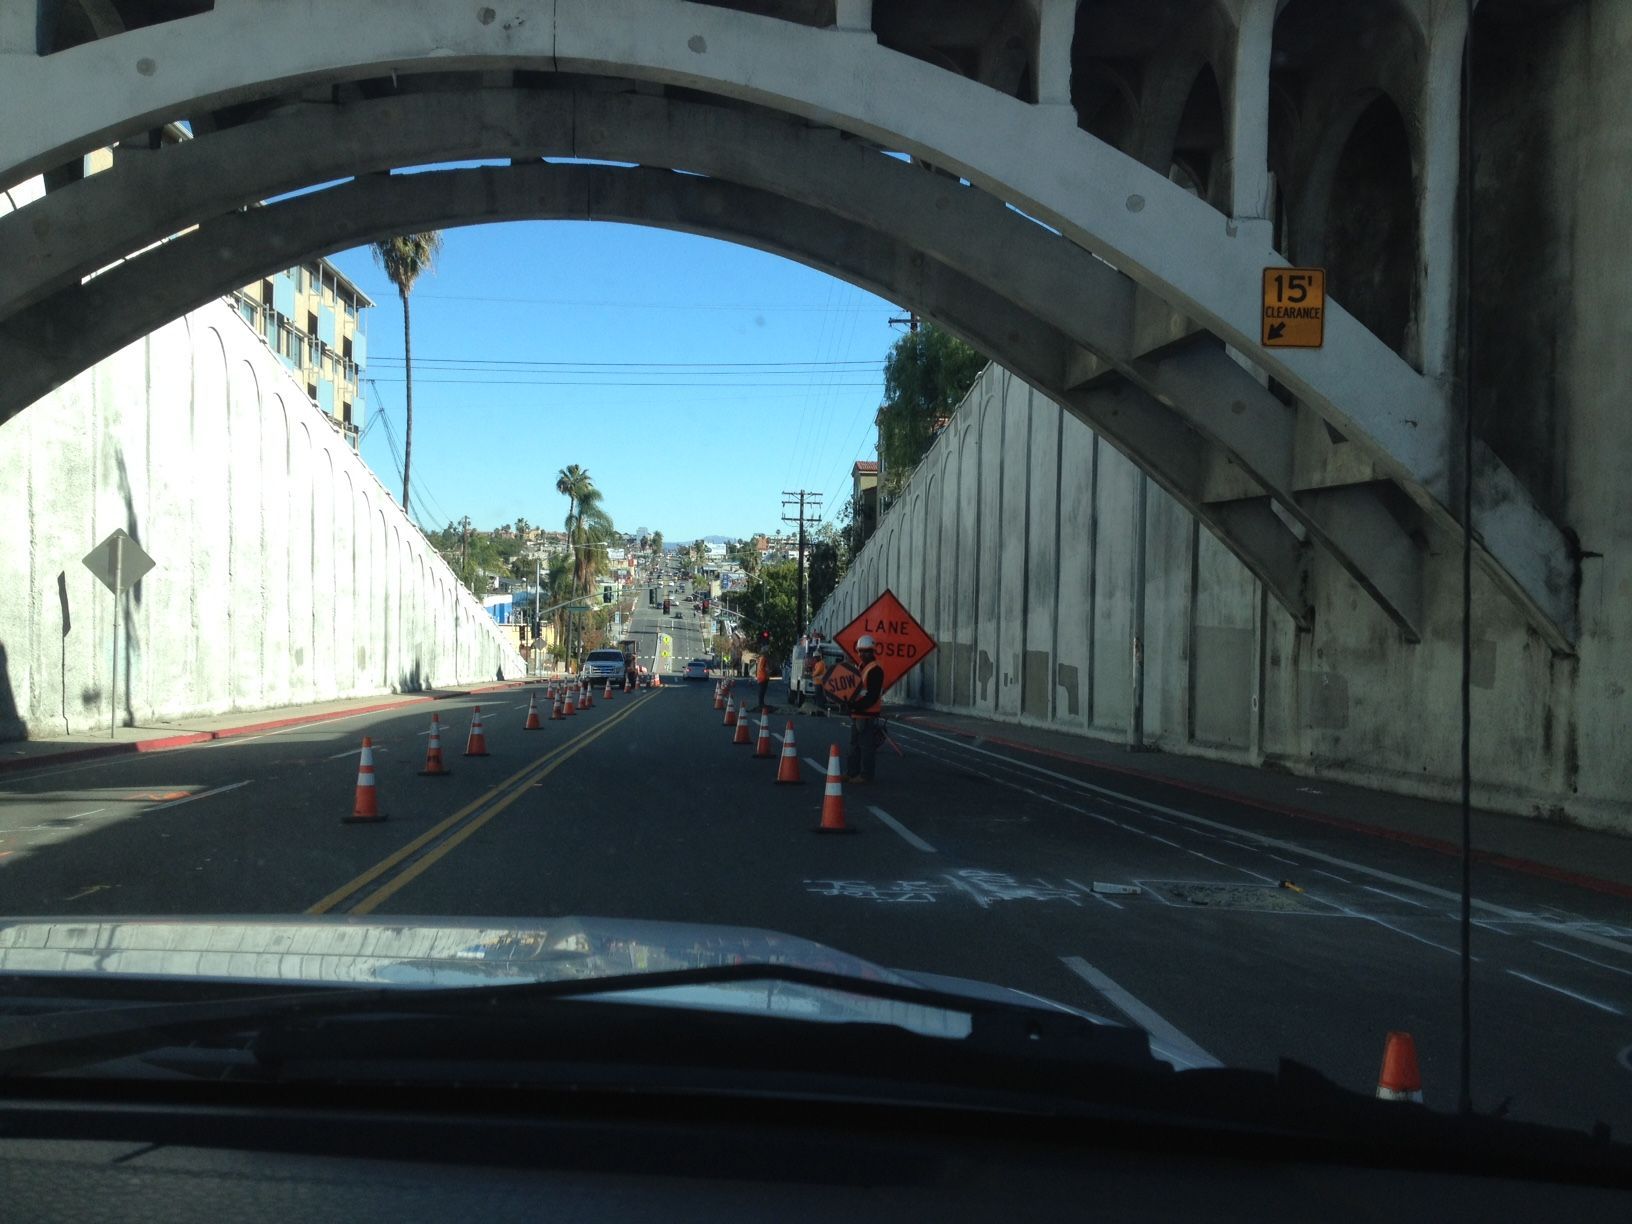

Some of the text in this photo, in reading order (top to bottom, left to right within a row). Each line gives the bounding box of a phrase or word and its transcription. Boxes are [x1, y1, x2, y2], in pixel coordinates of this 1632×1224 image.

[1274, 274, 1313, 303] 15'
[1265, 306, 1321, 319] CLEARANCE
[865, 619, 909, 635] LANE
[854, 641, 917, 658] OSED
[829, 674, 856, 692] SLOW
